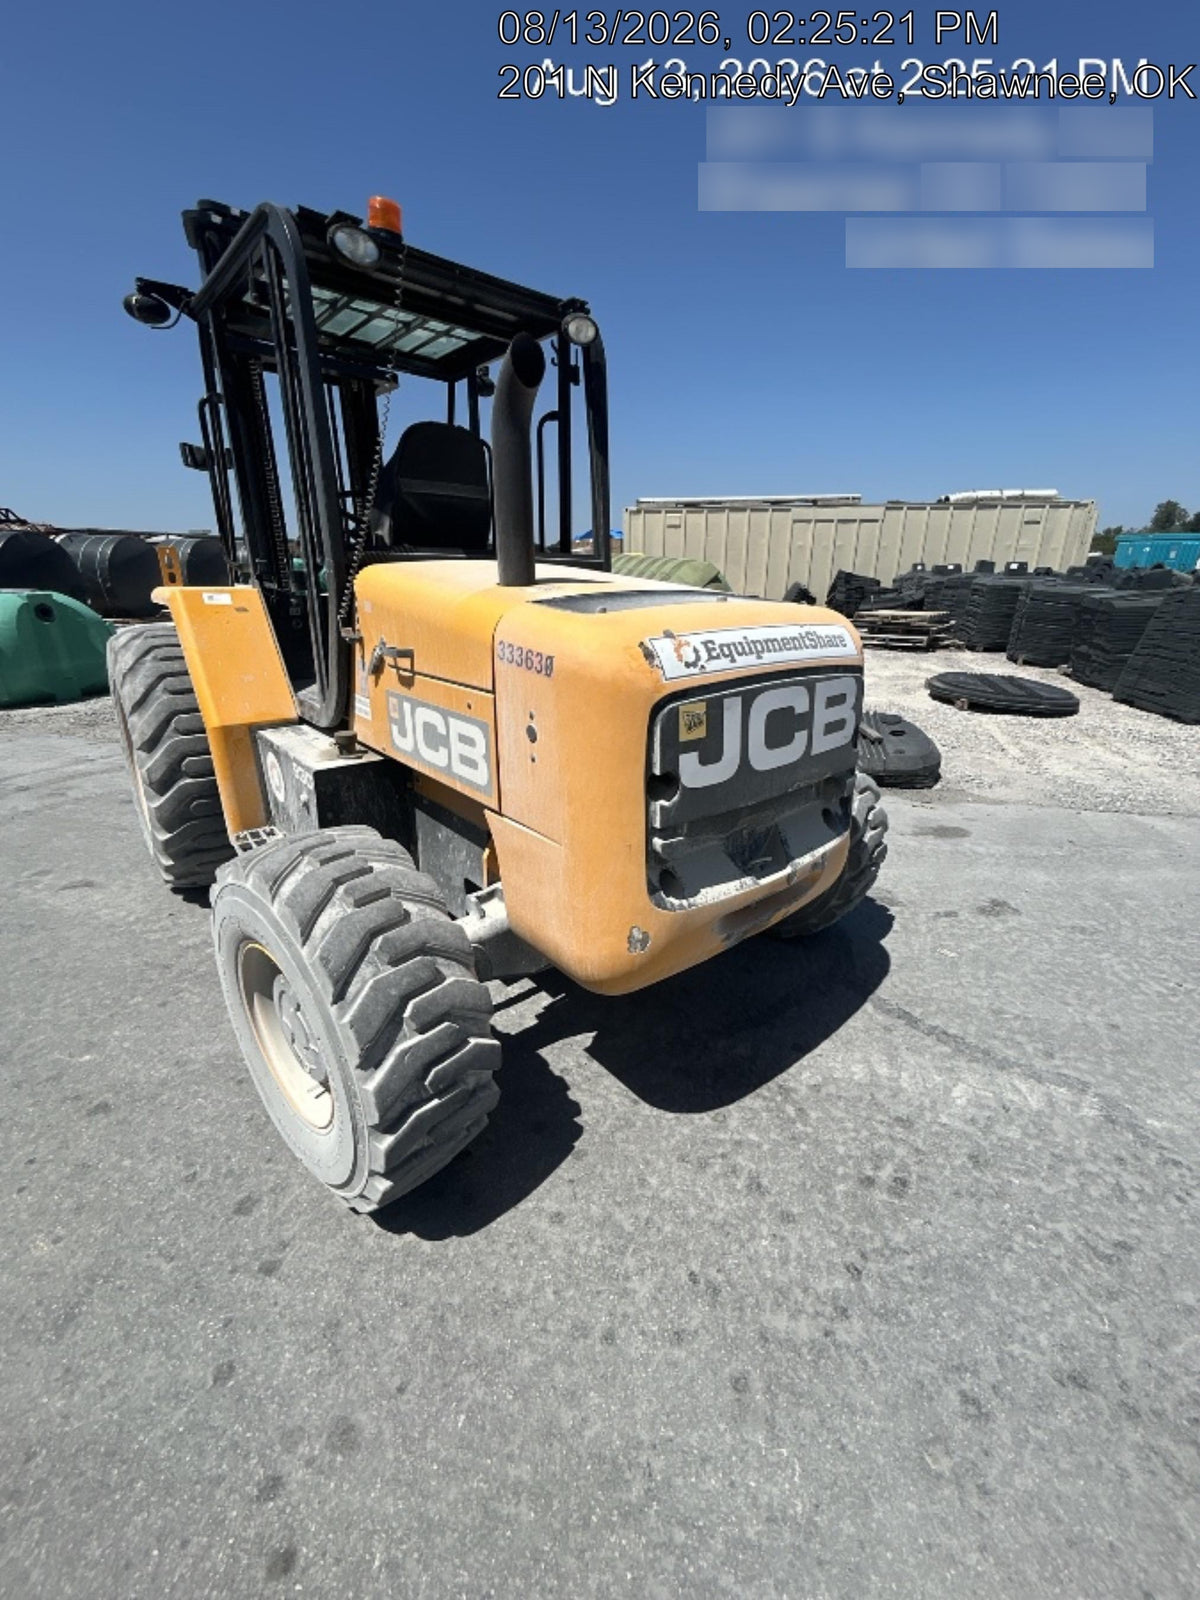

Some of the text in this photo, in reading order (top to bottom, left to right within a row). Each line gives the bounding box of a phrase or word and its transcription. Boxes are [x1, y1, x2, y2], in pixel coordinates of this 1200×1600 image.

[497, 640, 555, 677] 333630
[703, 632, 847, 665] EquipmentShare
[390, 700, 490, 787] JCB
[679, 677, 857, 789] JCB
